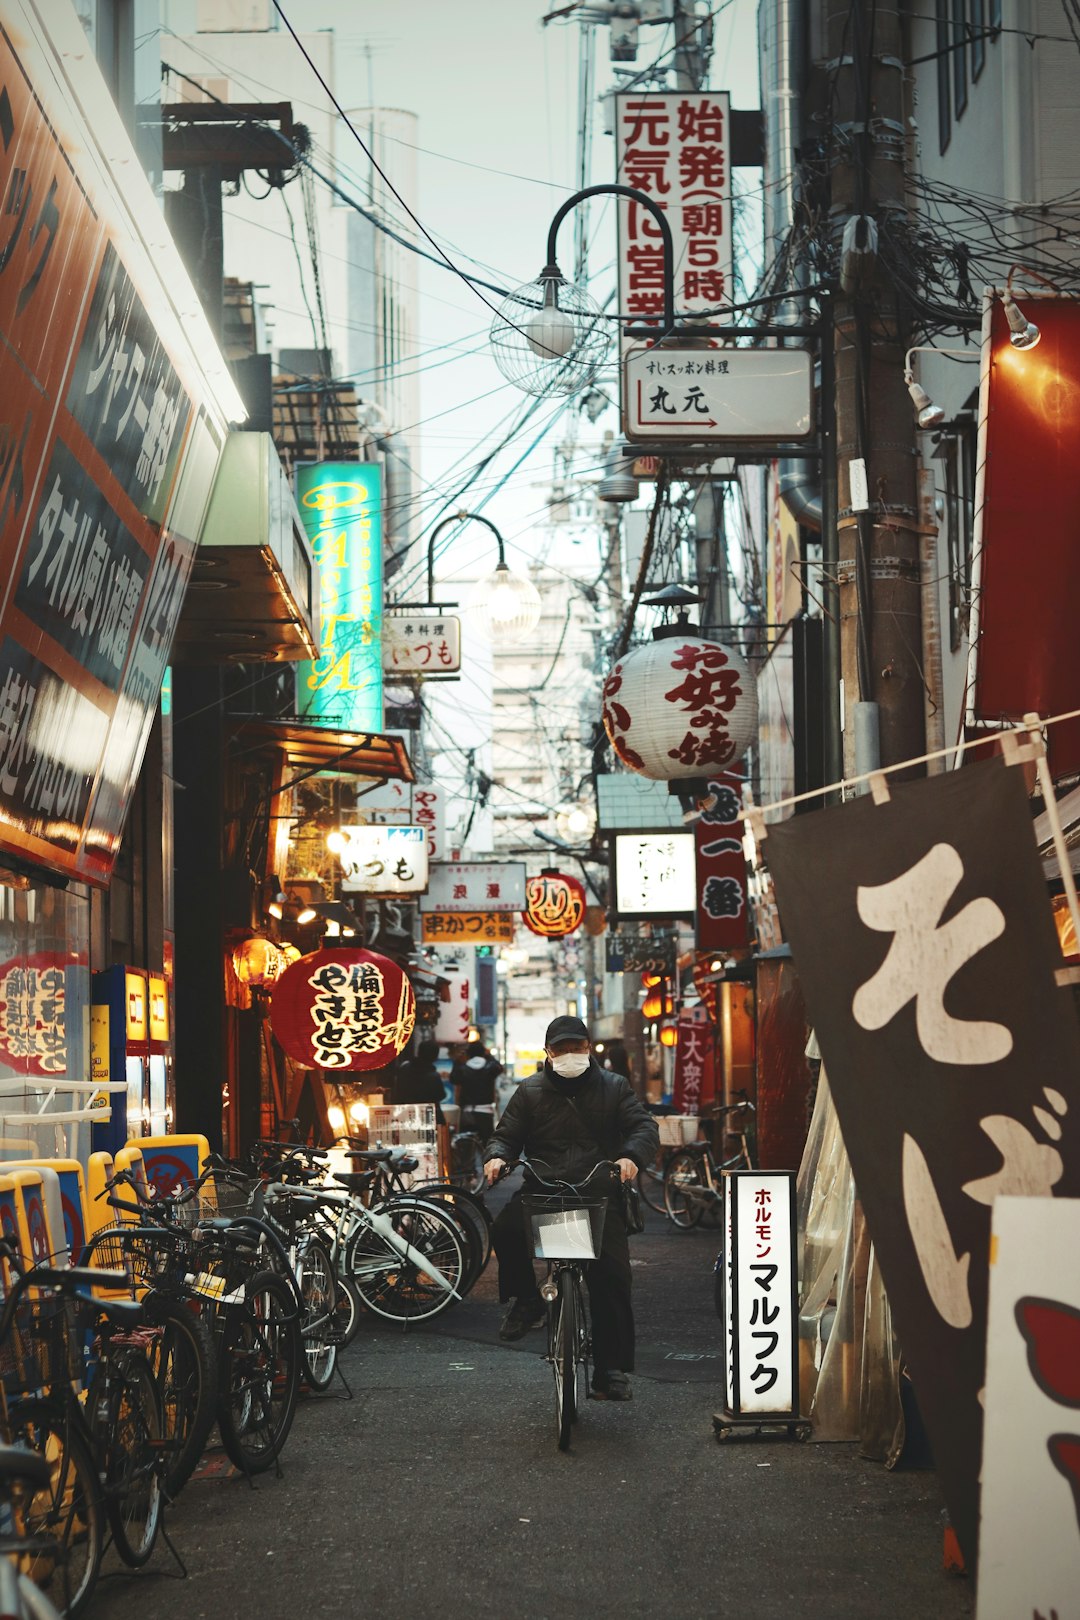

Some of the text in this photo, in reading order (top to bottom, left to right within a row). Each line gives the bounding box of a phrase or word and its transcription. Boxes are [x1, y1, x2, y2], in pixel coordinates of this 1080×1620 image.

[677, 100, 725, 346] 始発(朝5時
[86, 290, 180, 505] シャワー無料
[646, 360, 730, 376] すし・スッポン料理
[649, 385, 710, 414] 丸元
[27, 473, 144, 670] タオル使い放題
[426, 914, 484, 935] 串かつ
[312, 965, 347, 1066] やきとり
[348, 965, 380, 1049] 備長炭
[754, 1188, 772, 1258] ホルモン
[749, 1264, 780, 1395] マルフク
